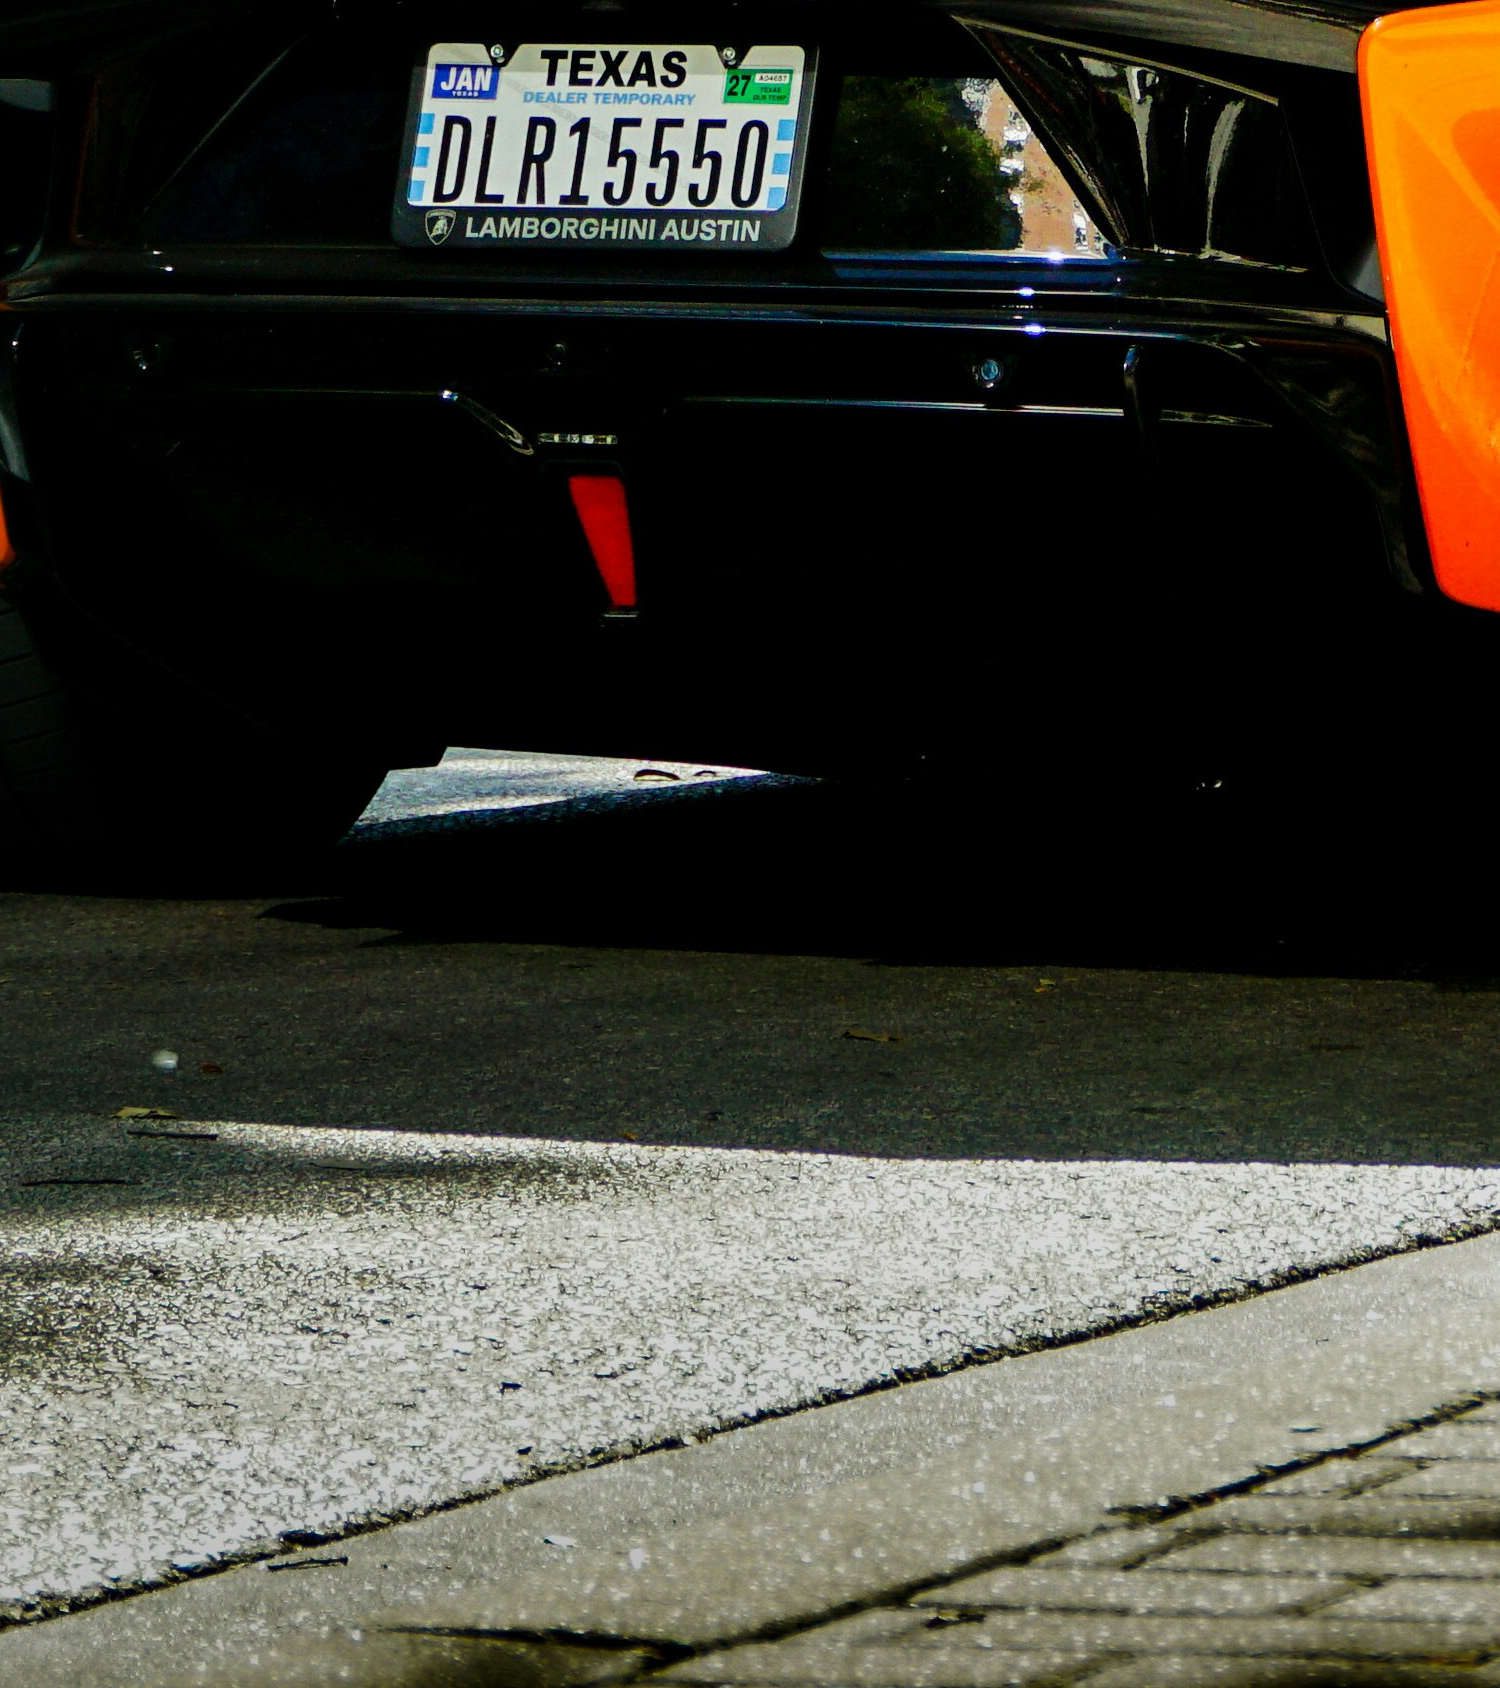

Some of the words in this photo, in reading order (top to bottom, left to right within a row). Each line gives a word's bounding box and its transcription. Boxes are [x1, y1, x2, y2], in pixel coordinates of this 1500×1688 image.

[440, 66, 493, 92] JAN
[540, 50, 688, 88] TEXAS
[522, 91, 588, 104] DEALER
[593, 92, 697, 106] TEMPORARY
[727, 74, 752, 97] 27
[432, 114, 769, 209] DLR15550
[464, 216, 656, 241] LAMBORGHINI
[660, 218, 761, 242] AUSTIN
